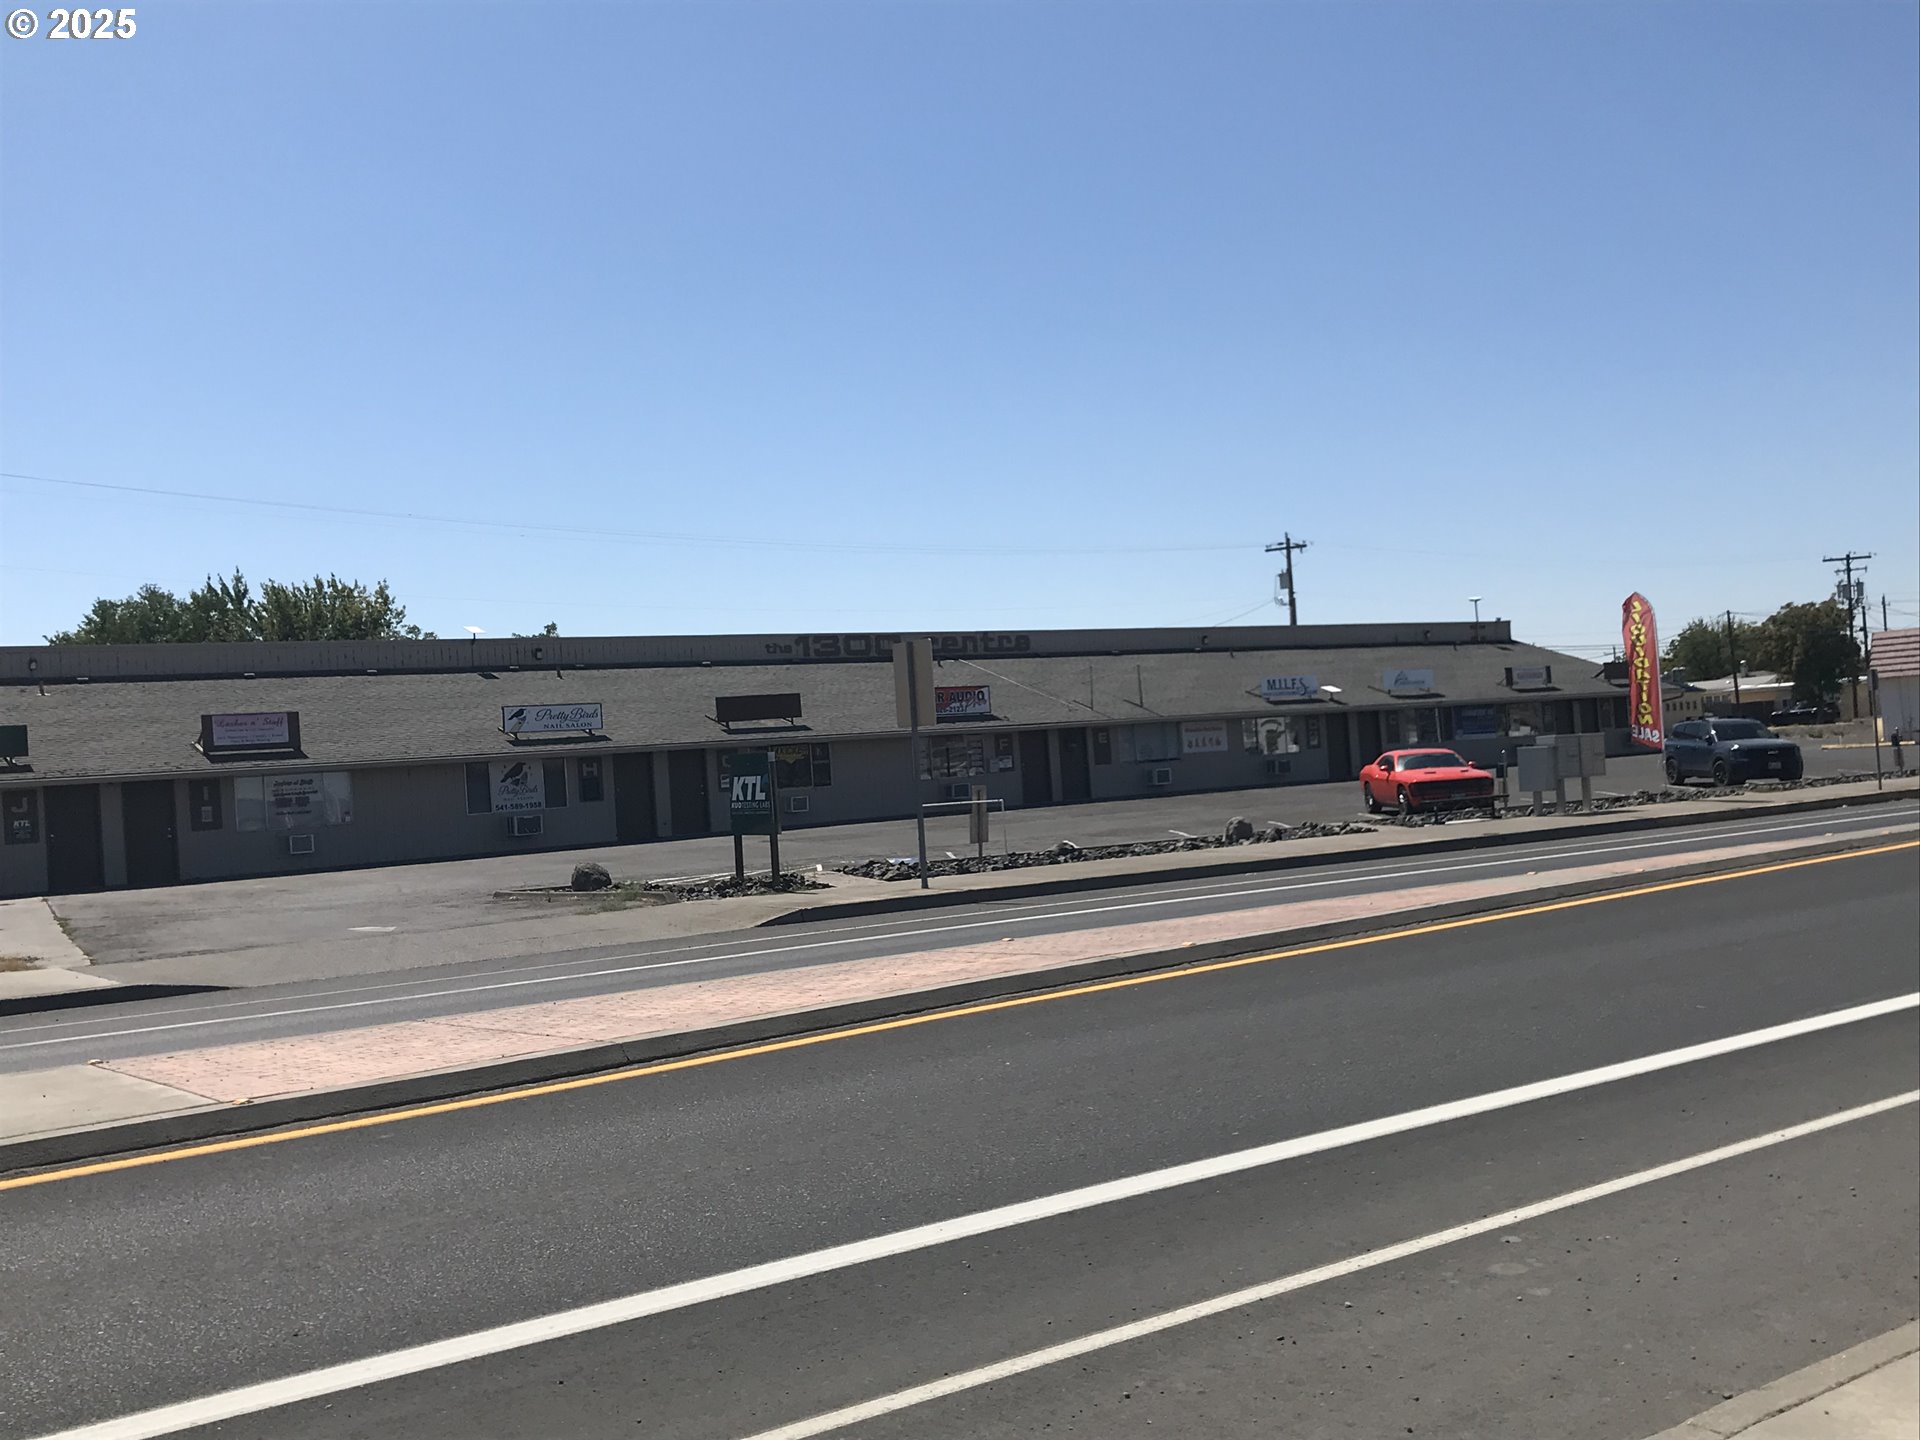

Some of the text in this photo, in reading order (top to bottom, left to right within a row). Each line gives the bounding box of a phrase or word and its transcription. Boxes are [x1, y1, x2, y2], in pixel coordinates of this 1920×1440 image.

[765, 643, 792, 654] the
[922, 632, 1031, 653] entre
[535, 707, 598, 723] Pretty Birds
[582, 763, 598, 777] H
[732, 775, 766, 801] KTL
